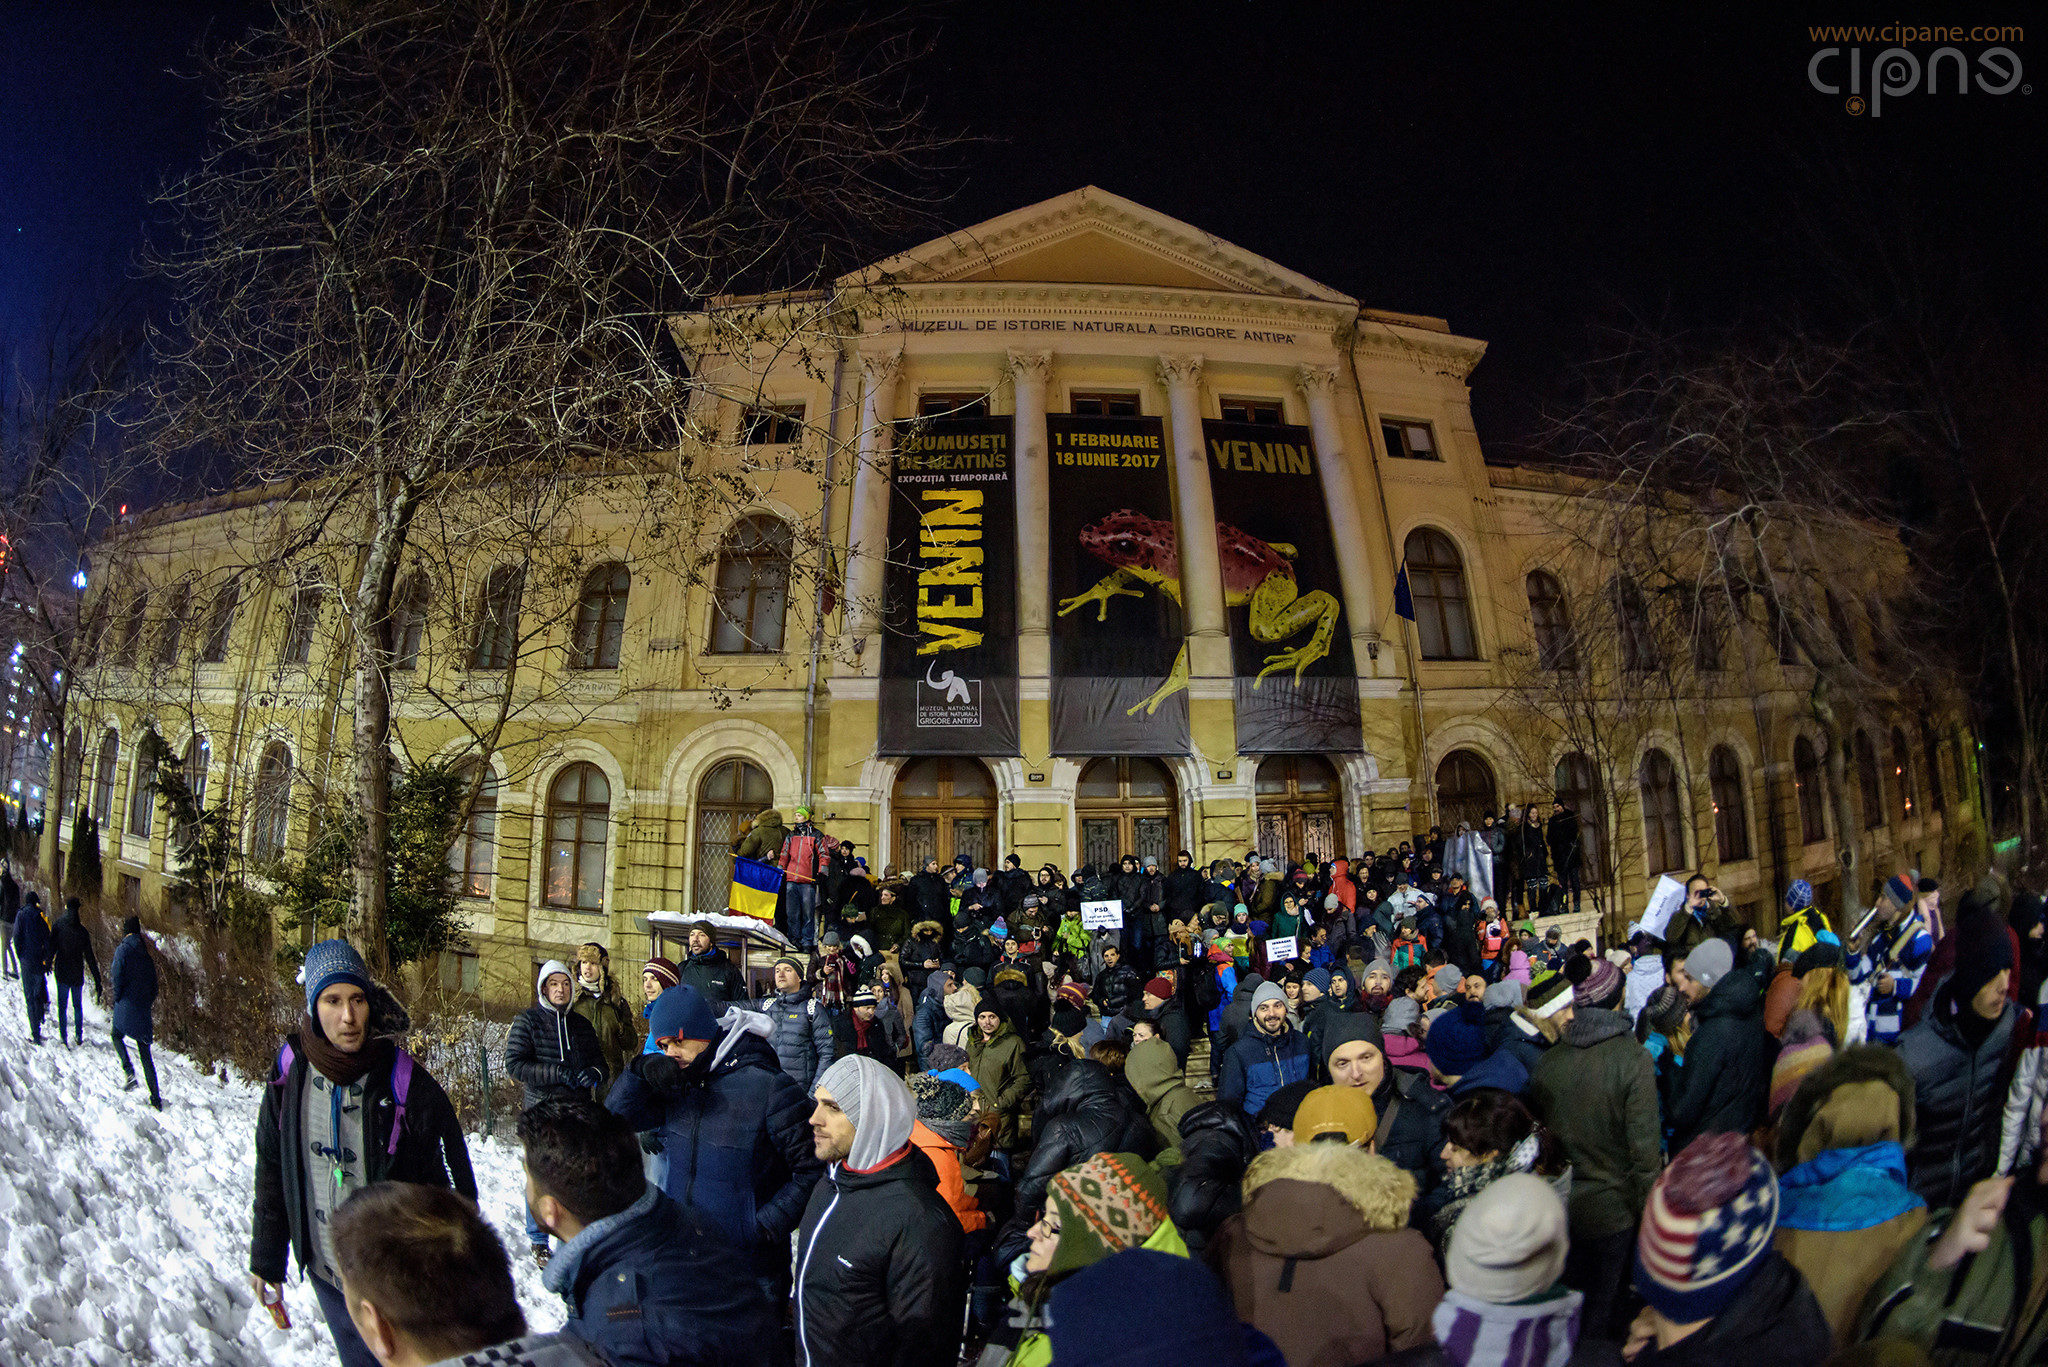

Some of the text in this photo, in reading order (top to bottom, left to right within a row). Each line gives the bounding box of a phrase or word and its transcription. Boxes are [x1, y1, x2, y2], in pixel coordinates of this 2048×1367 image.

[901, 320, 968, 332] MUZEUL
[976, 320, 997, 331] DE
[1004, 320, 1067, 331] ISTORIE
[1073, 321, 1157, 334] NATURALA
[1055, 433, 1159, 449] 1 FEBRUARIE
[929, 454, 1007, 470] NEATINS
[1056, 452, 1160, 468] 18 IUNIE 2017
[1210, 438, 1312, 476] VENIN
[950, 471, 1008, 482] TEMPORARĂ
[916, 488, 984, 656] VENIN
[920, 717, 979, 725] GRIGORE ANTIPA
